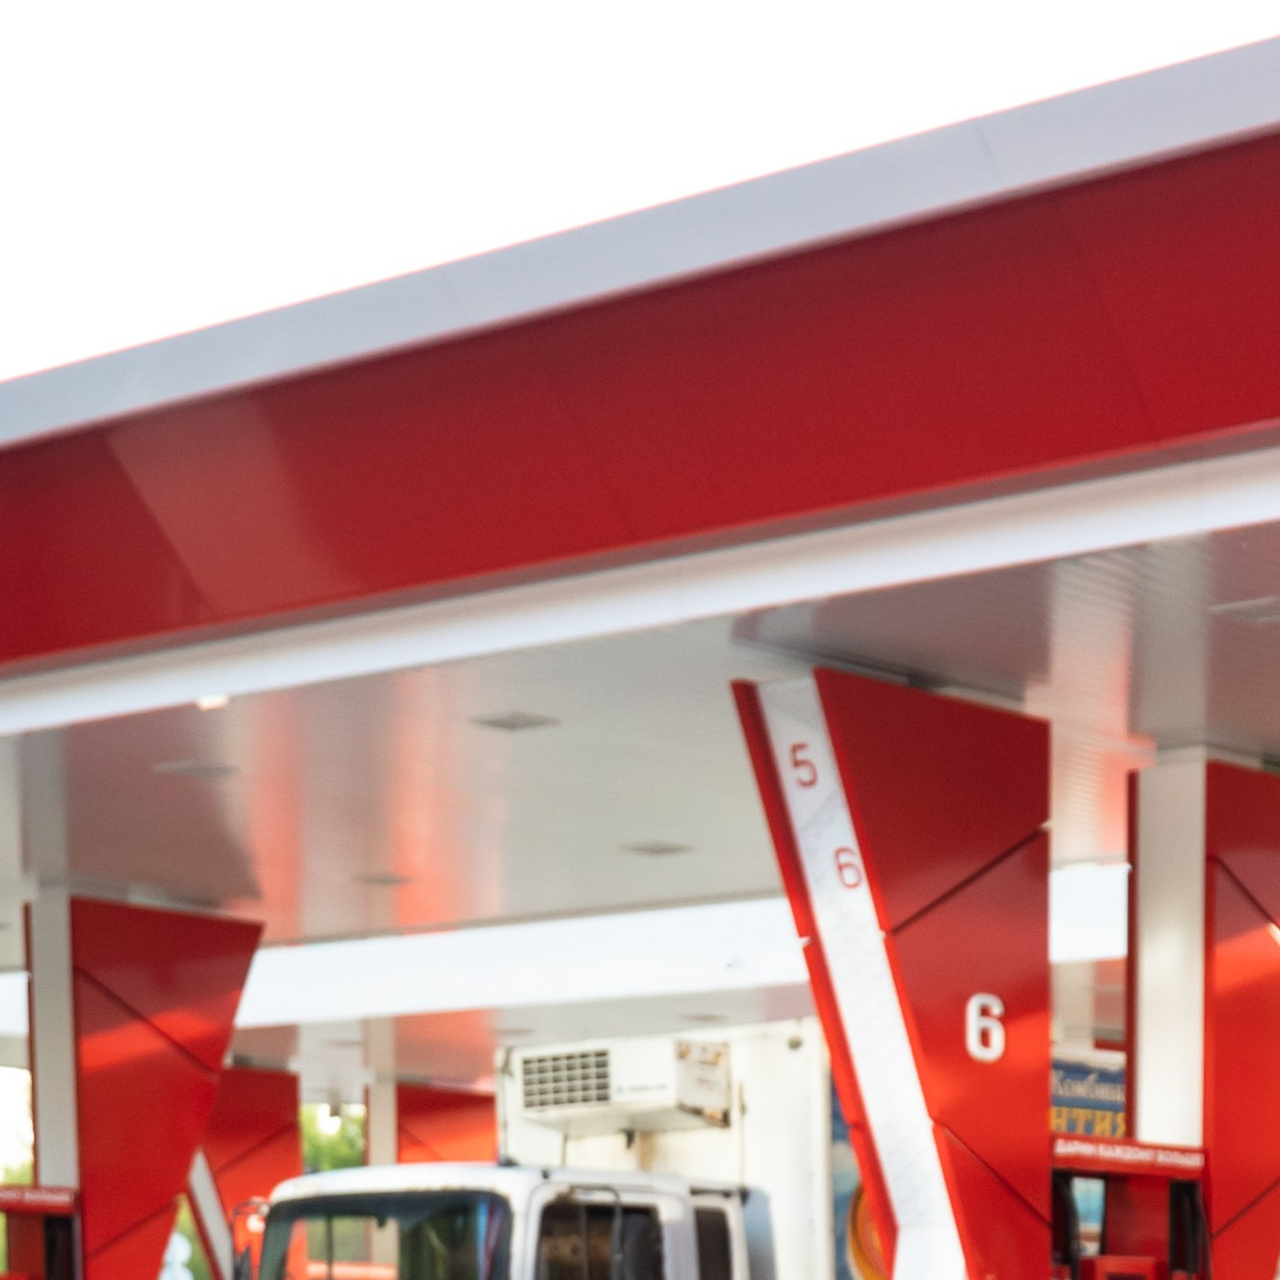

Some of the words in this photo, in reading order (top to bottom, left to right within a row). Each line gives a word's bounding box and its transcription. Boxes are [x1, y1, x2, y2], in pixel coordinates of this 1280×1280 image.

[790, 741, 819, 789] 5
[833, 847, 863, 890] 6
[964, 992, 1006, 1064] 6
